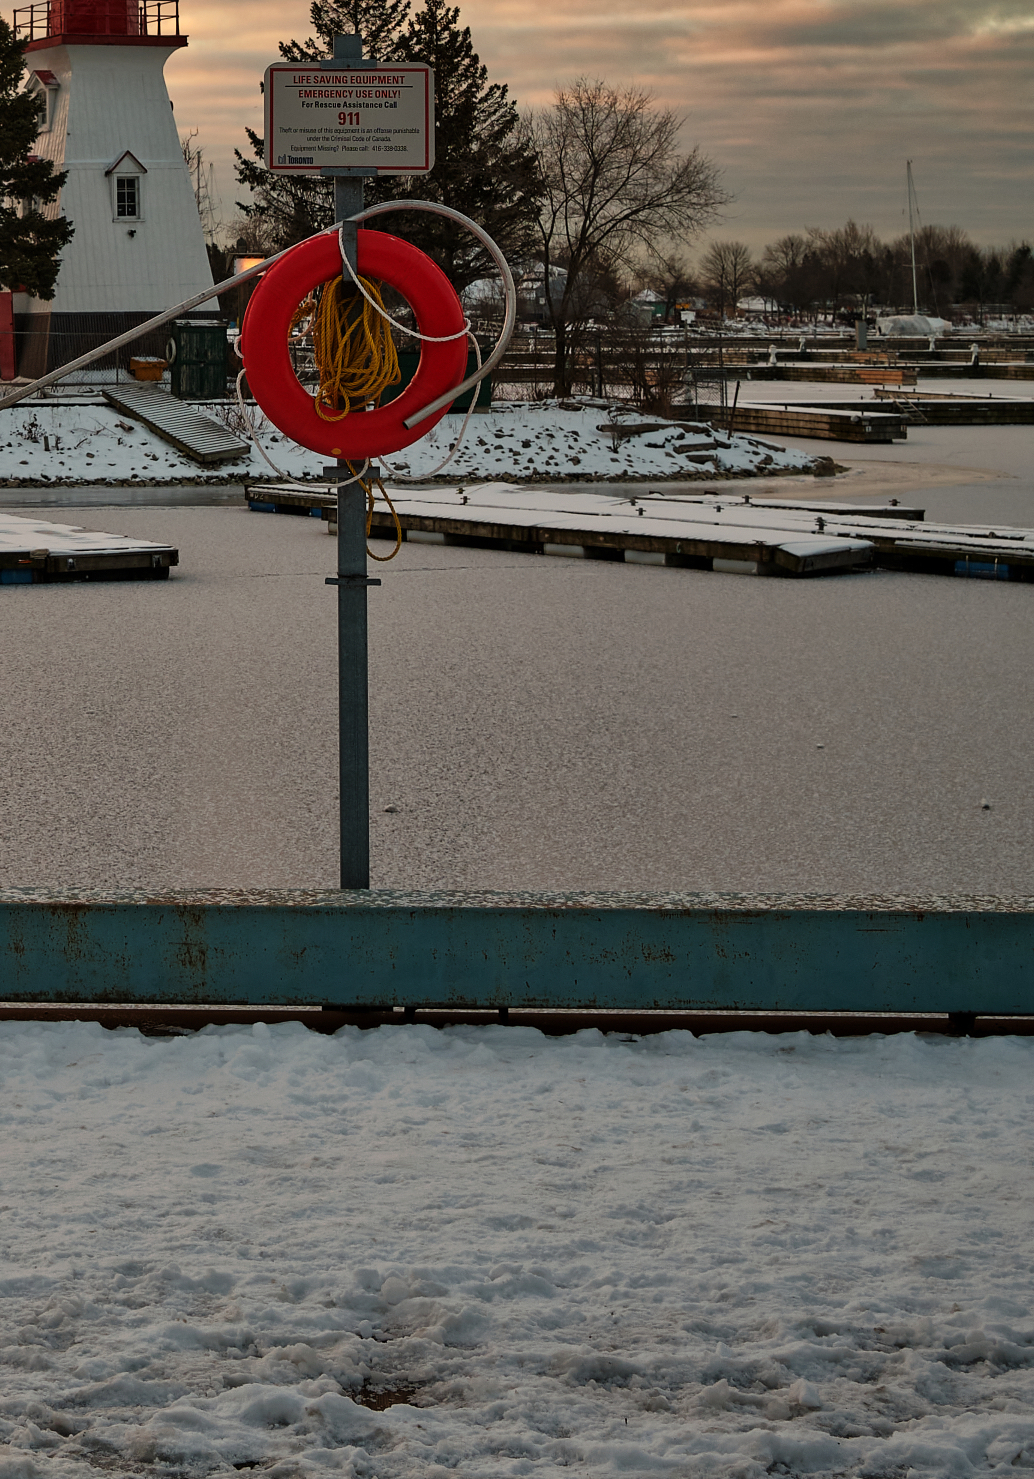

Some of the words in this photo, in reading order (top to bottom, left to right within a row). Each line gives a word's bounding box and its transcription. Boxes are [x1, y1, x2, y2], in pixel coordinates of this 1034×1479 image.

[293, 75, 312, 84] LIFE
[313, 75, 348, 84] SAVING
[350, 75, 406, 84] EQUIPMENT
[298, 89, 354, 99] EMERGENCY
[355, 89, 372, 98] USE
[374, 89, 401, 98] ONLY!
[301, 101, 313, 109] For
[314, 101, 341, 109] Rescue
[342, 101, 383, 109] Assistance
[384, 101, 398, 109] Call
[338, 111, 360, 126] 911
[290, 144, 317, 152] Equipment
[317, 144, 339, 152] Missing?
[287, 155, 314, 164] TORONTO
